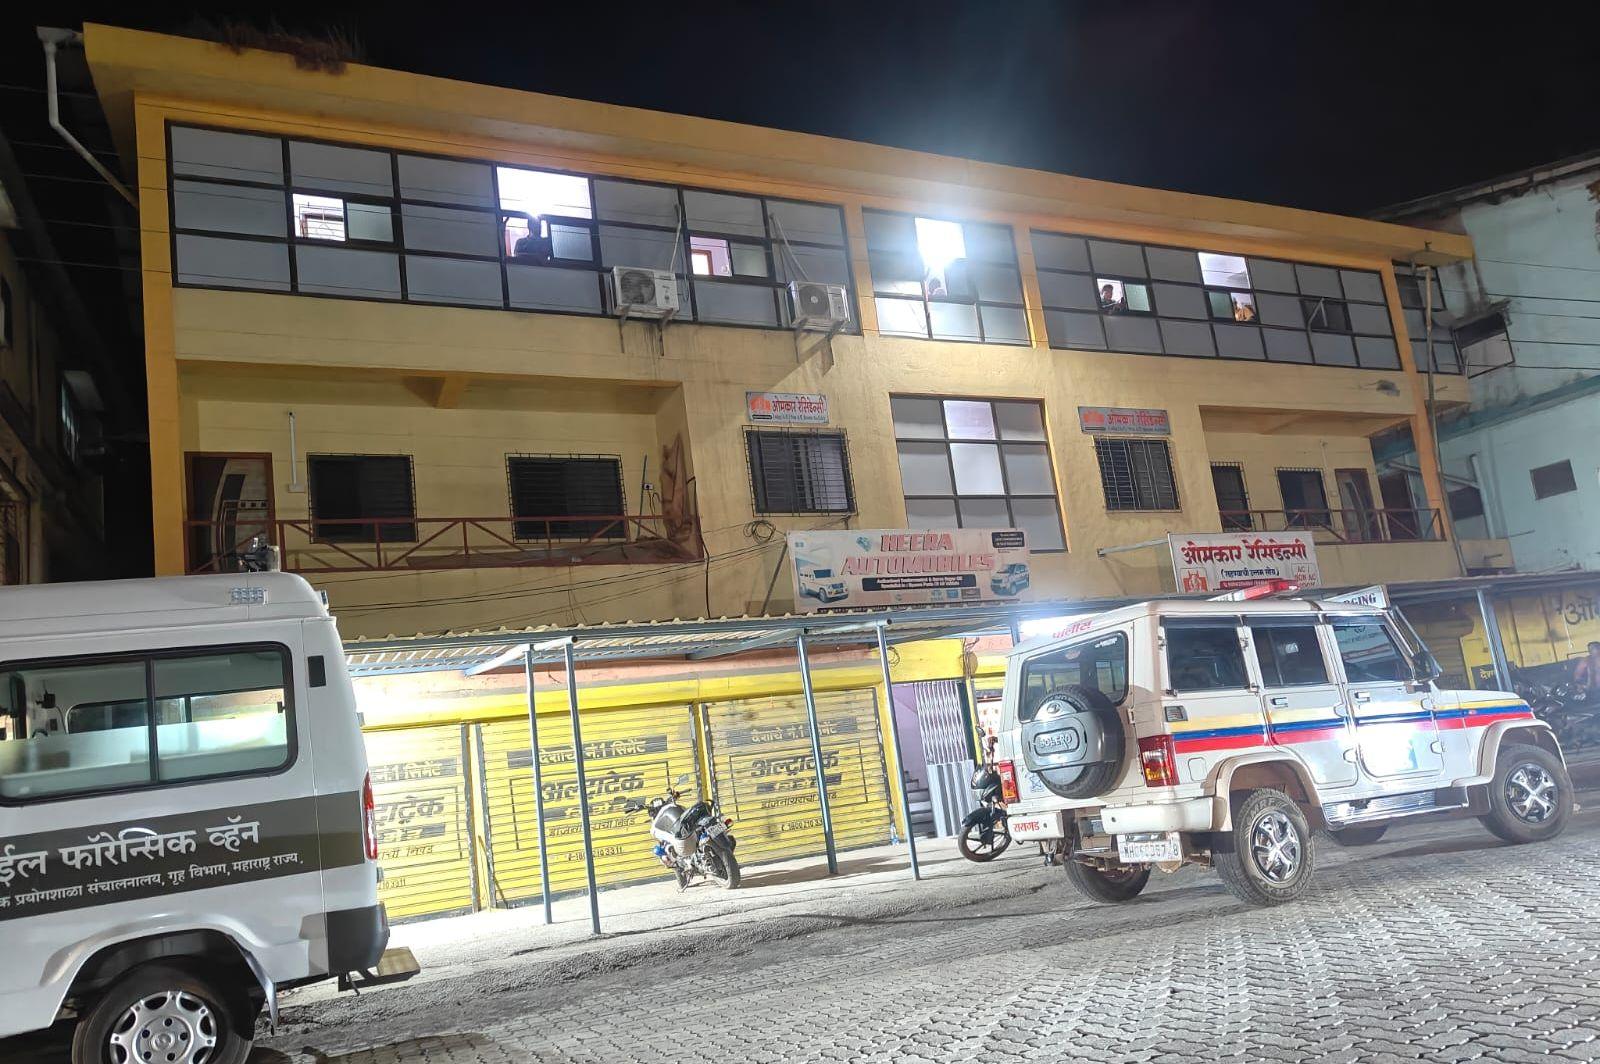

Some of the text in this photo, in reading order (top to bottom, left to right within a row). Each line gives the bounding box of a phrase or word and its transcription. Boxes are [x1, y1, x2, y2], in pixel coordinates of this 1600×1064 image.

[880, 533, 955, 552] HEERA
[1180, 540, 1242, 564] ओमकार
[840, 553, 996, 577] AUTOMOBILES
[58, 827, 198, 870] फॉरेन्सिक
[205, 815, 260, 852] व्हॅन
[14, 885, 83, 906] प्रयोगशाळा
[86, 873, 165, 895] संचालनालय,
[168, 870, 185, 886] गृह
[189, 864, 231, 879] विभाग,
[232, 857, 272, 872] महाराष्ट्र
